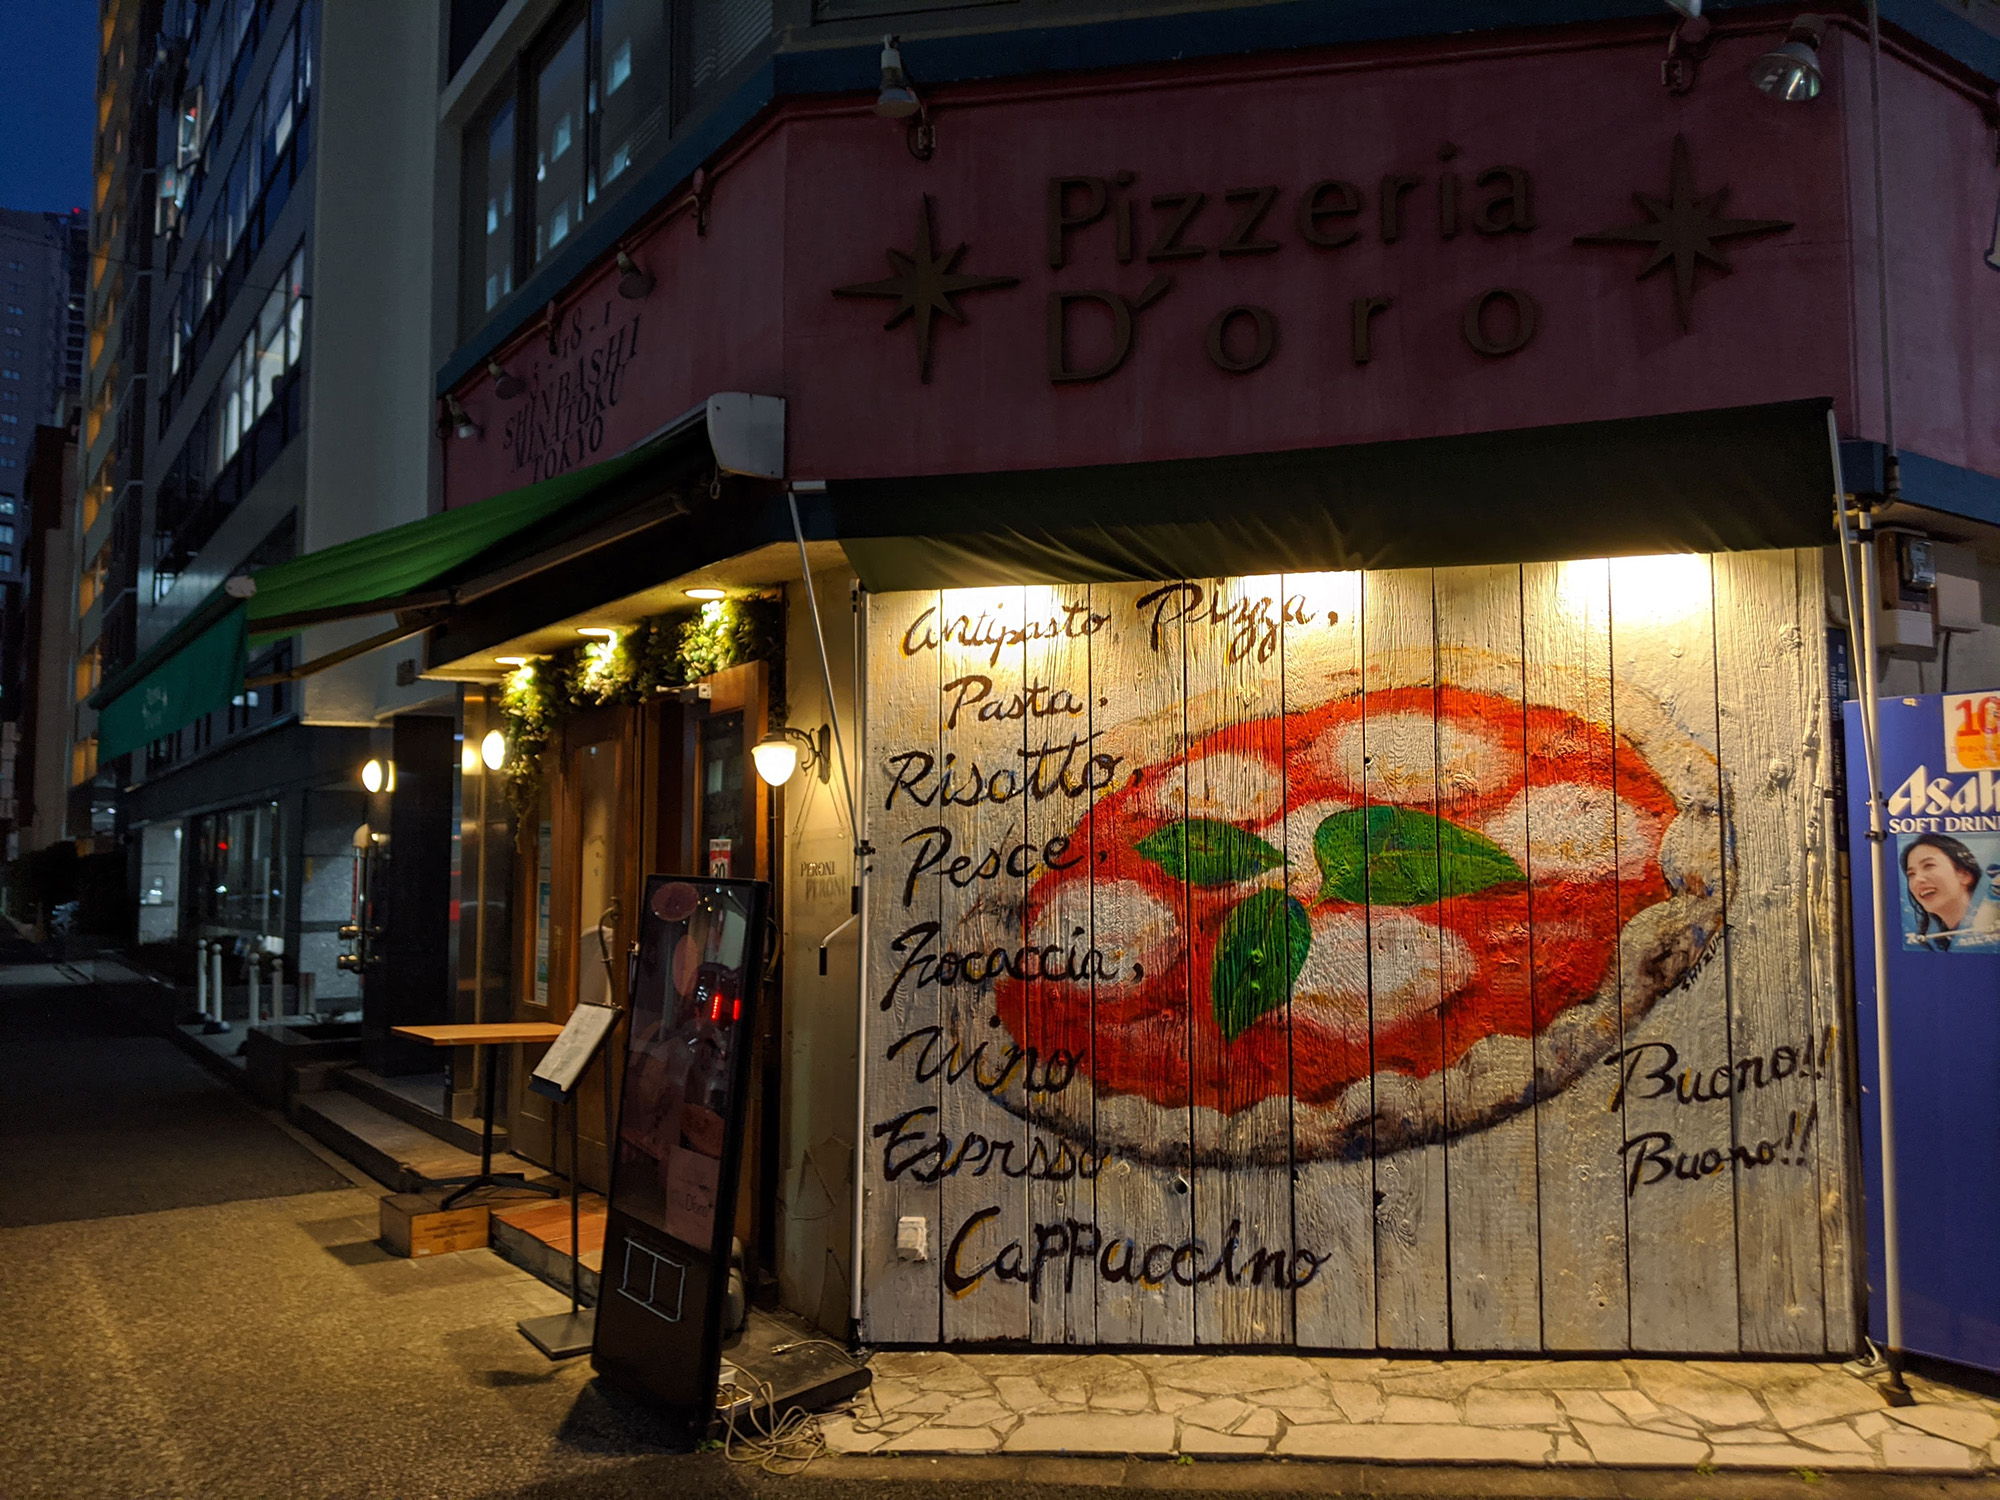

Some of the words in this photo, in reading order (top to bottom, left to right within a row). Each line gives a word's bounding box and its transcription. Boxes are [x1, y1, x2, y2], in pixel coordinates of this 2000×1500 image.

[1049, 141, 1535, 271] Pizzeria
[531, 416, 604, 484] TOKYO
[1889, 817, 1941, 834] SOFT
[1944, 815, 2000, 832] DRIN
[886, 1015, 1085, 1094] Vino
[1603, 1024, 1836, 1113] Buono!!
[1616, 1101, 1817, 1198] Buono!!
